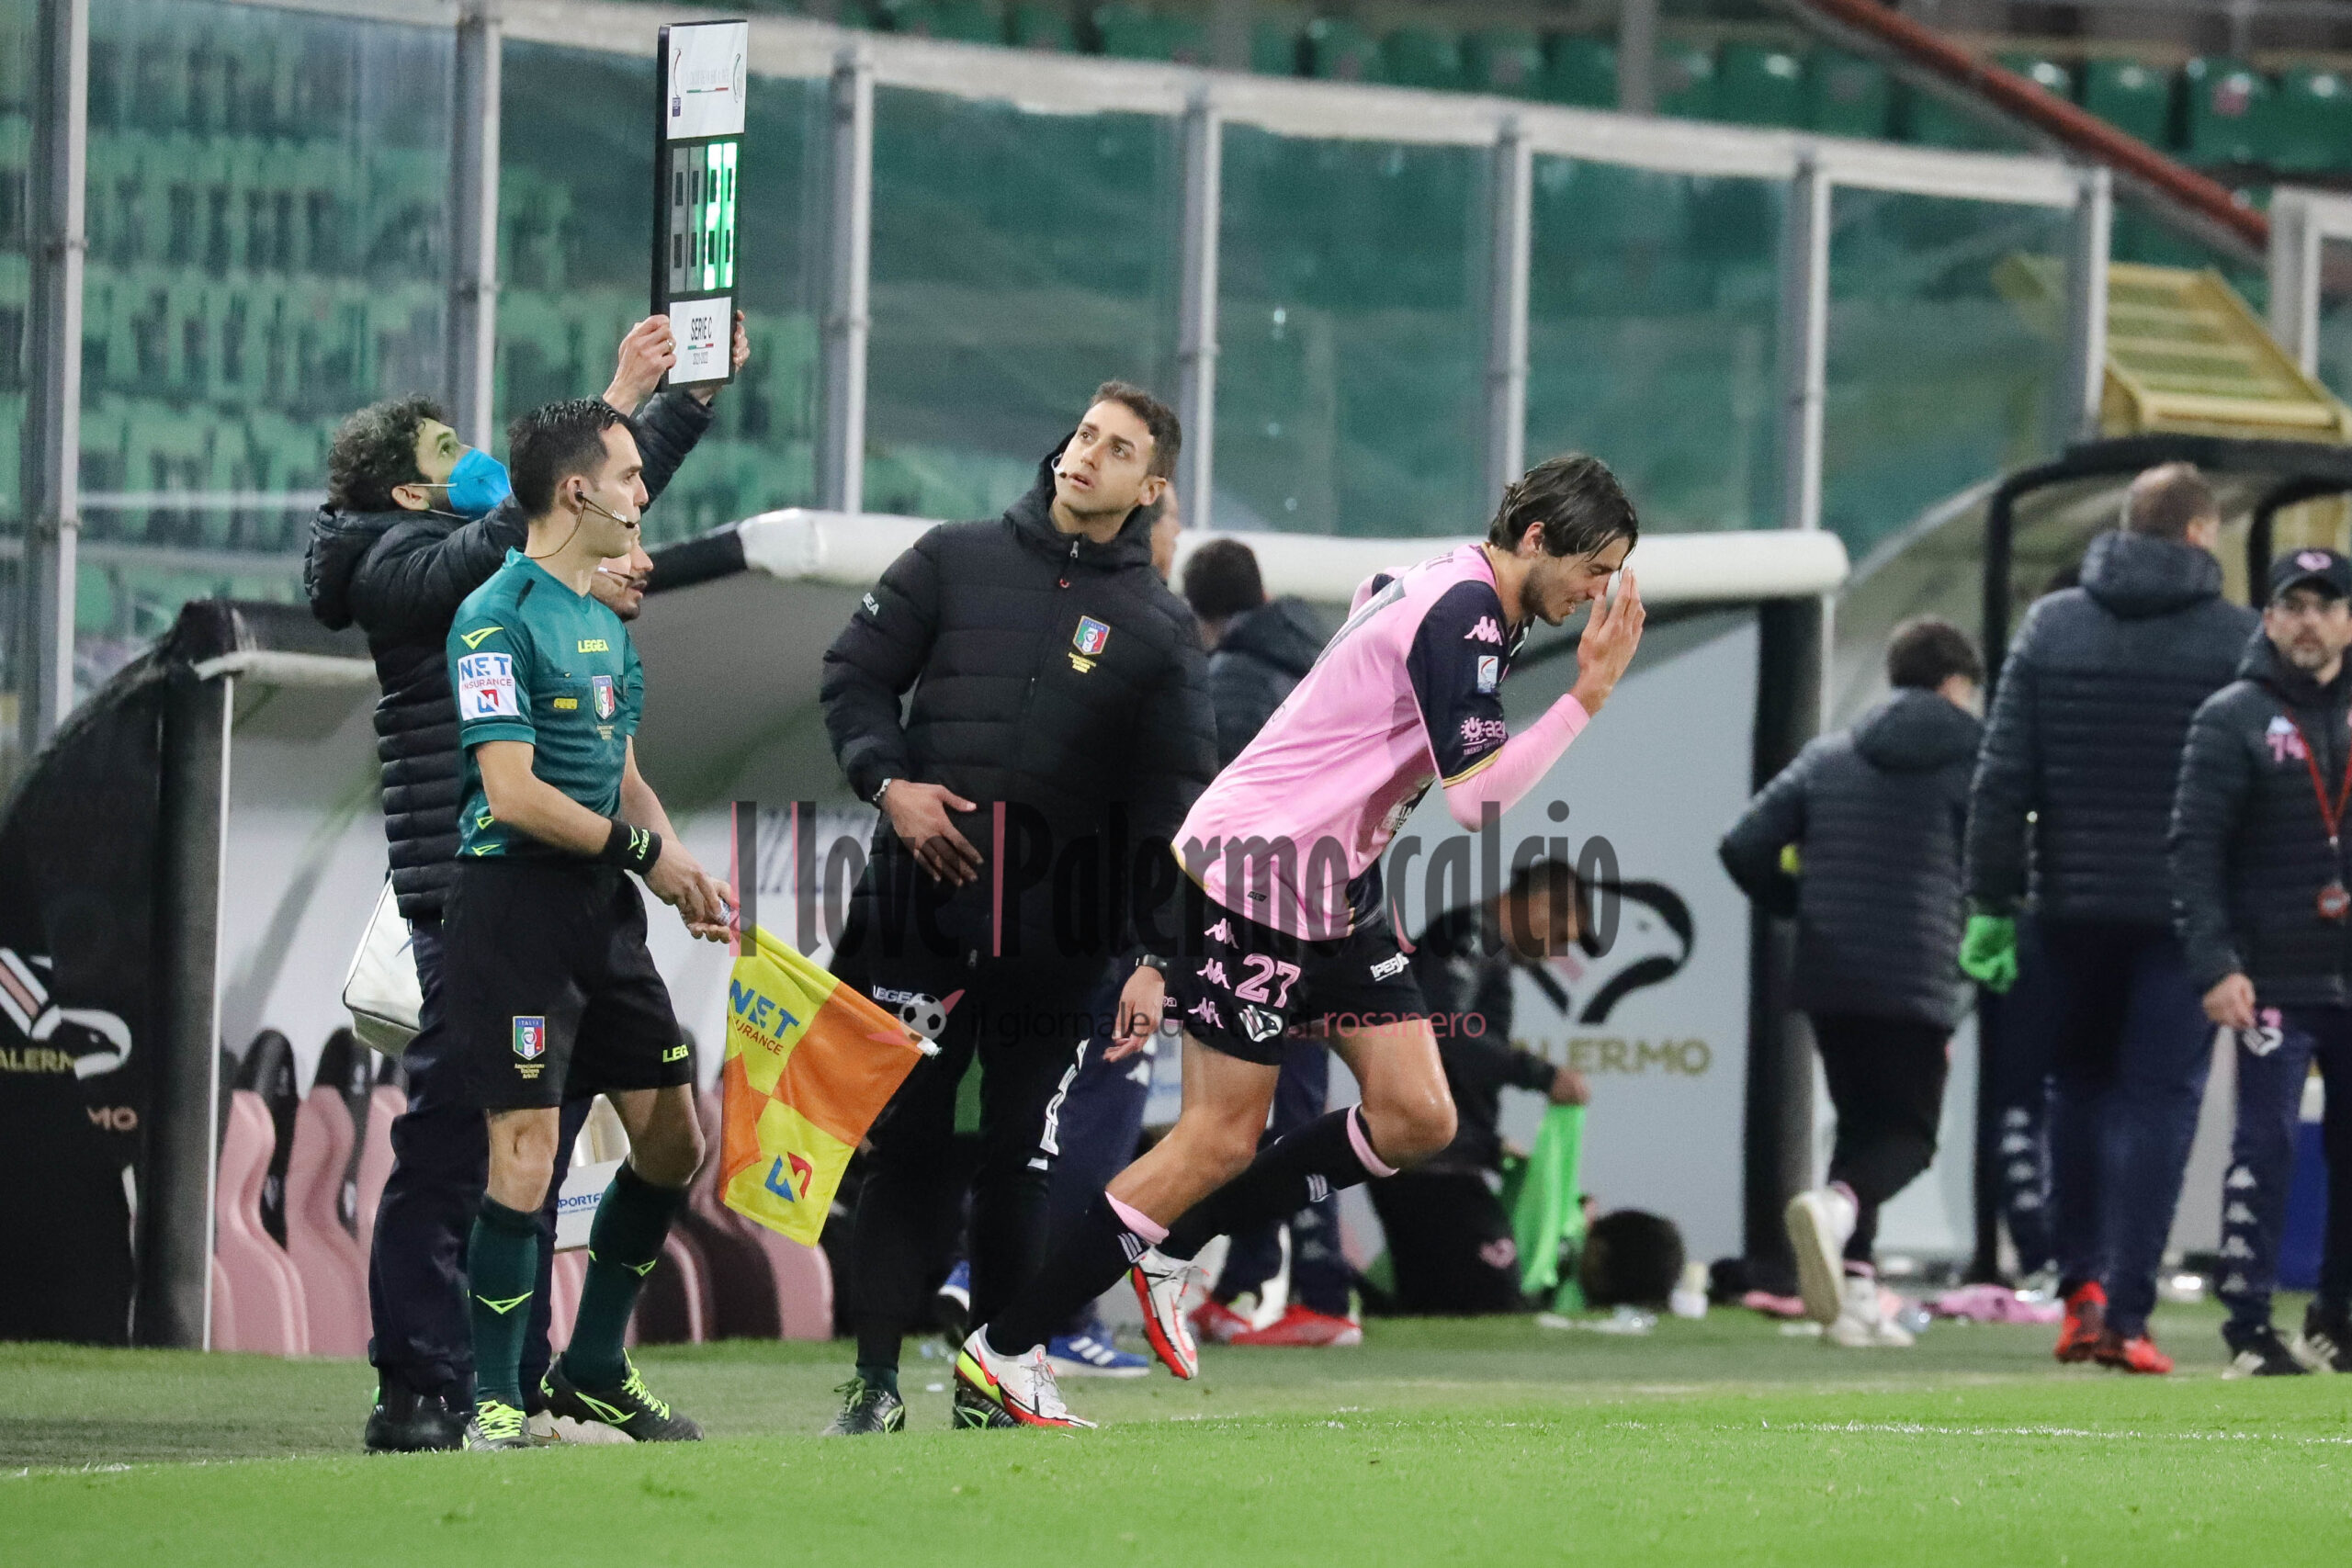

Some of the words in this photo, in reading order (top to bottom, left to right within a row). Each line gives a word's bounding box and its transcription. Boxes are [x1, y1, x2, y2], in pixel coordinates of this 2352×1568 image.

[691, 317, 707, 341] SERIE
[707, 316, 713, 339] C
[460, 656, 509, 681] NET
[461, 678, 513, 691] INSURANCE
[1234, 953, 1301, 1009] 27
[729, 978, 800, 1040] NET
[556, 1192, 605, 1209] PORTF
